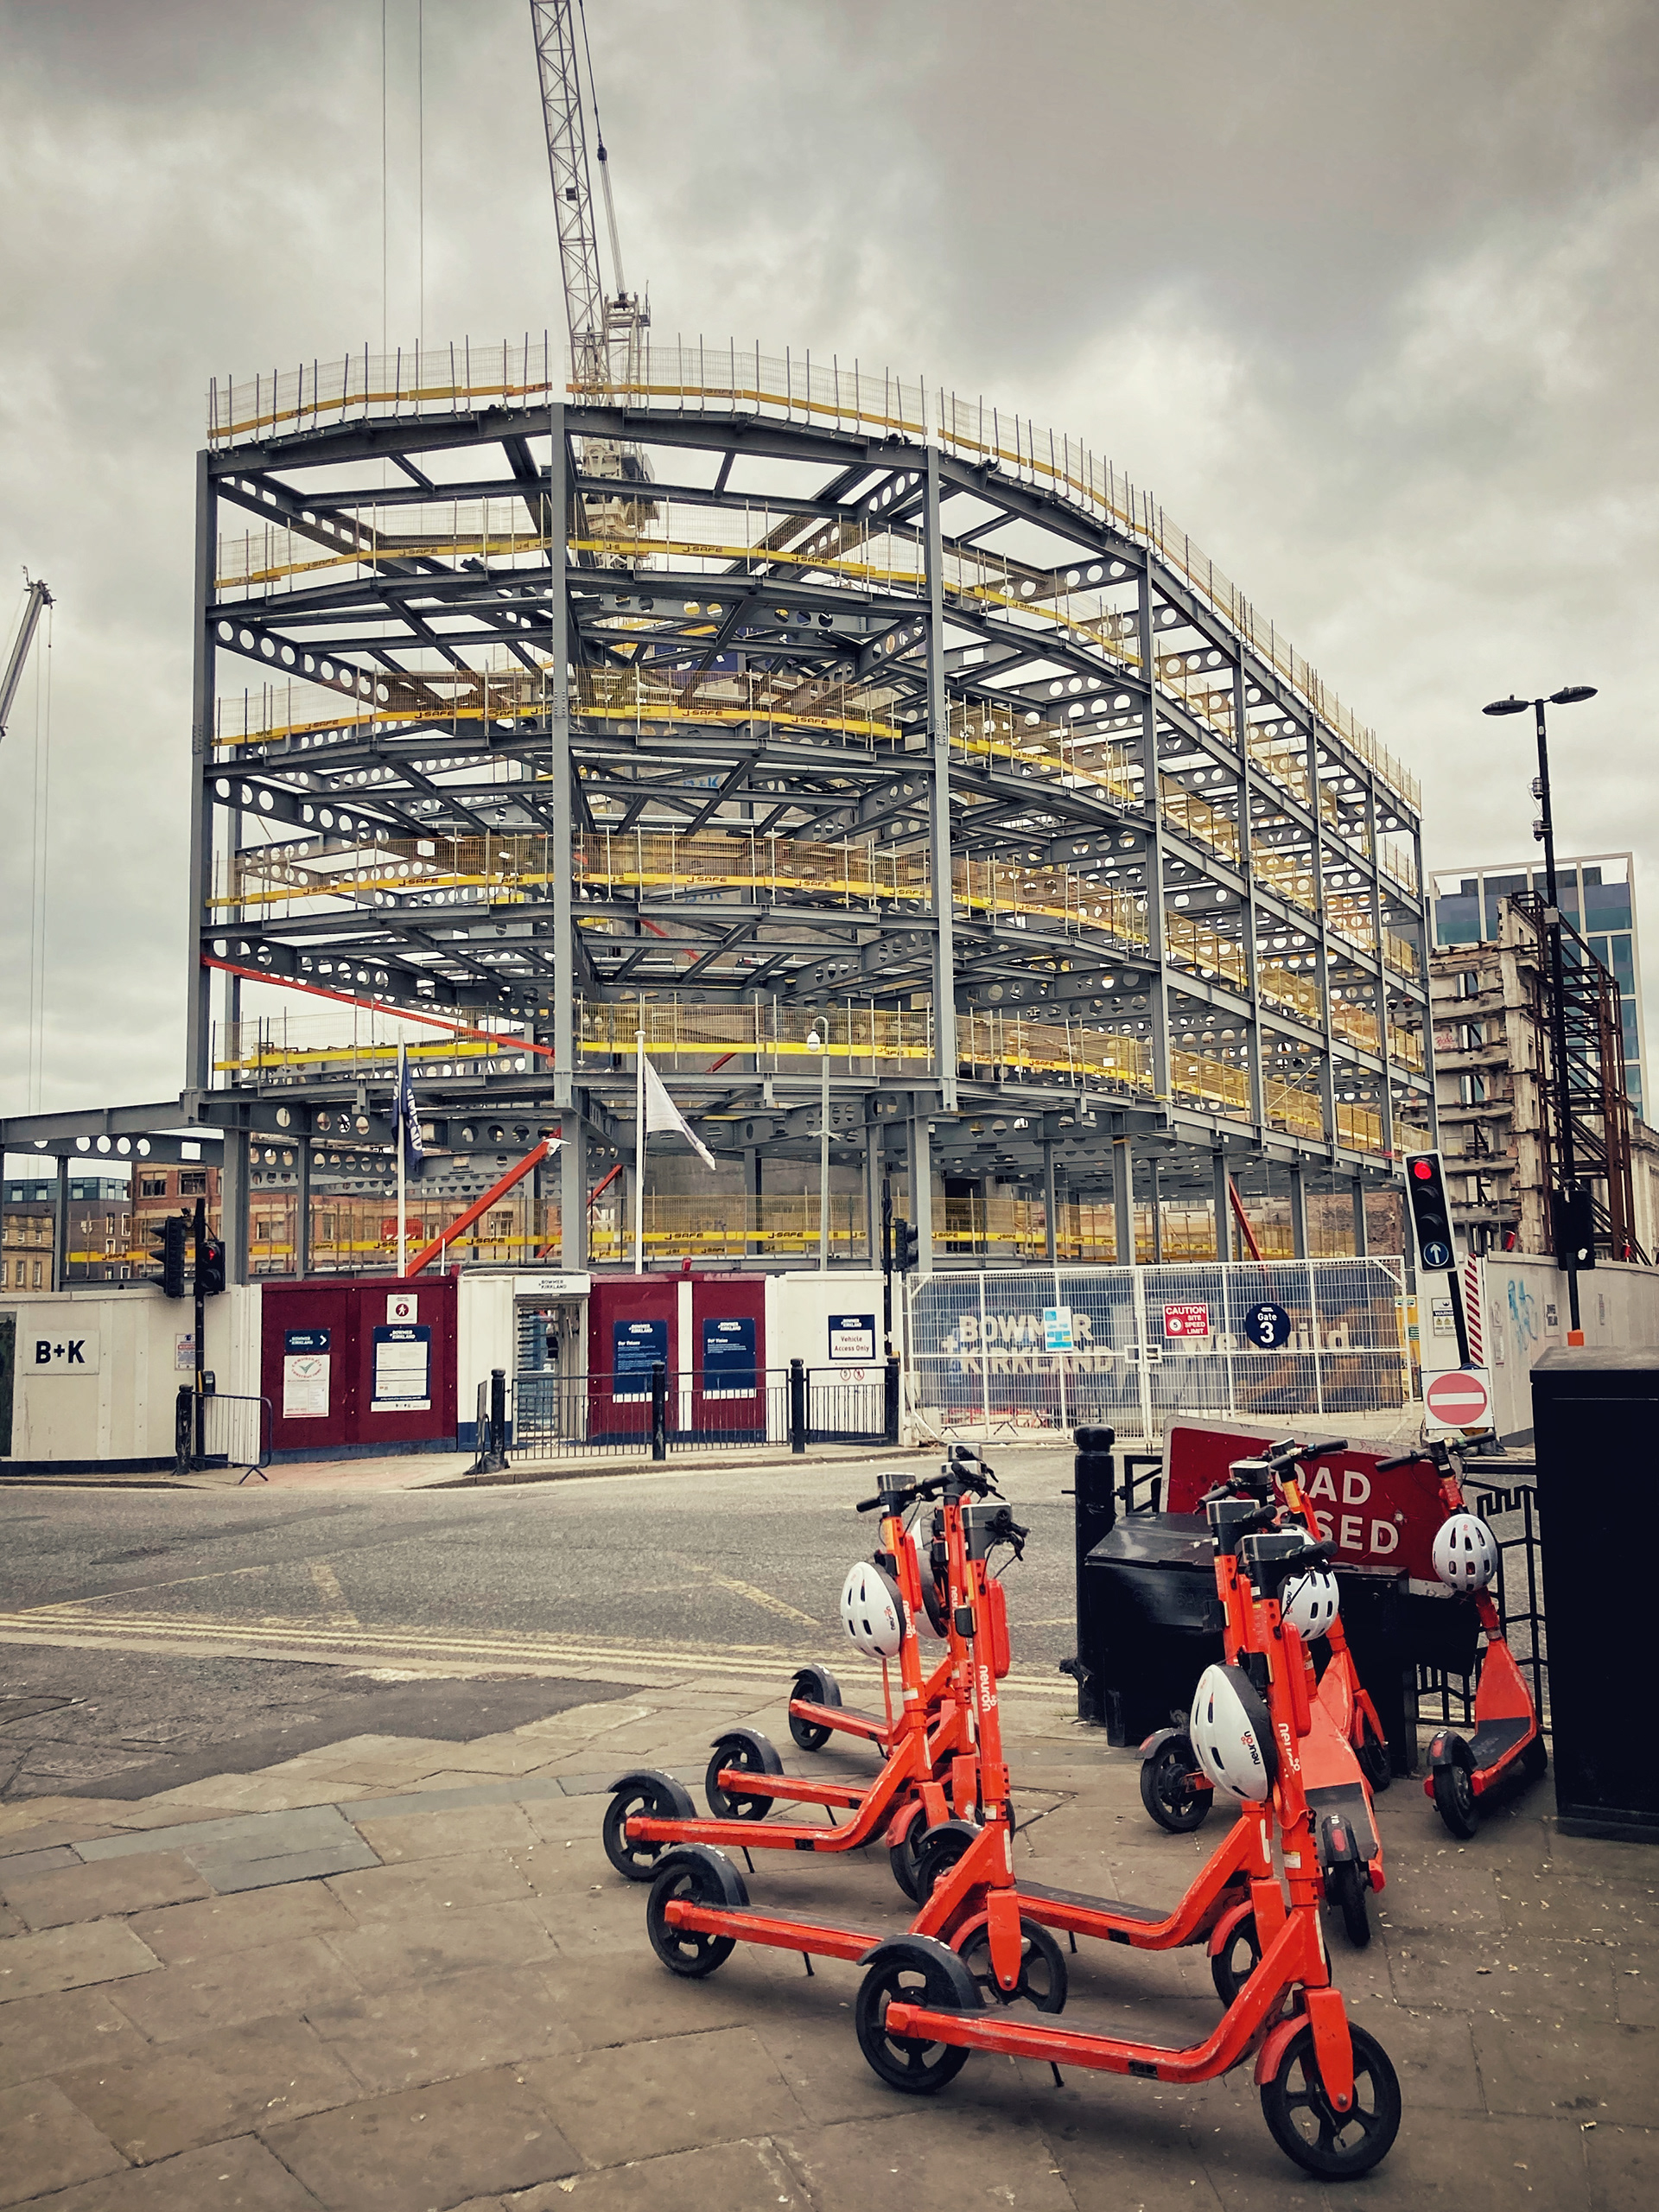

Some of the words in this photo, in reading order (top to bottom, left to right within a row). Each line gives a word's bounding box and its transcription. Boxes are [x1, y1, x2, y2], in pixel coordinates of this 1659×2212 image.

[1166, 1306, 1206, 1315] CAUTION
[1257, 1313, 1278, 1321] Gate
[959, 1313, 1094, 1342] BOWMR
[1260, 1321, 1274, 1344] 3
[35, 1340, 86, 1363] B+K
[1275, 1463, 1370, 1505] OAD
[979, 1664, 999, 1713] neuron
[1240, 1730, 1261, 1765] neuron
